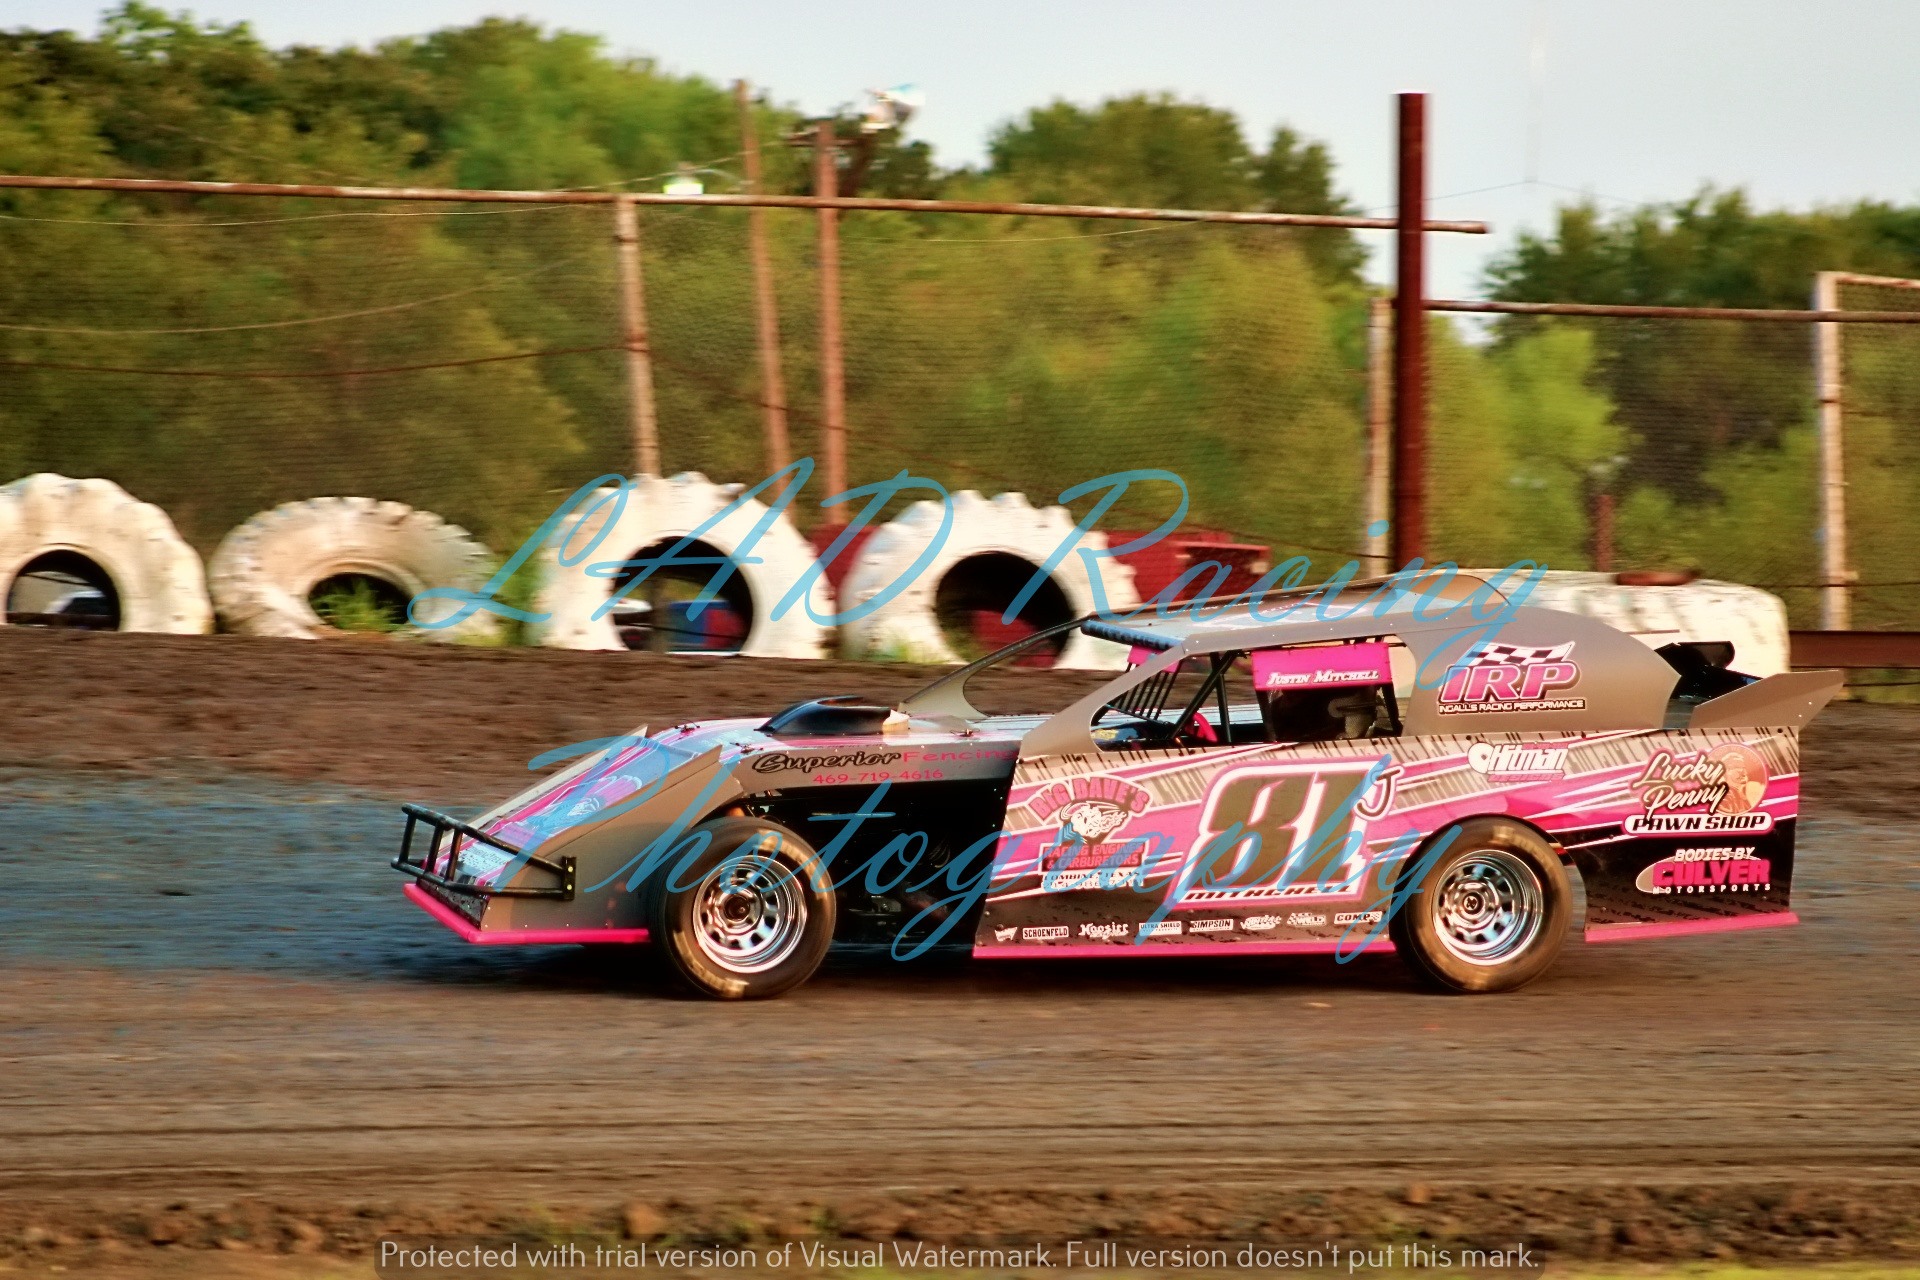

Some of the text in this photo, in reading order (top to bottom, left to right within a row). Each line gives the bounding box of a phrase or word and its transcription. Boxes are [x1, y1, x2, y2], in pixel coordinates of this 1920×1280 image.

[1440, 662, 1580, 703] IRP
[1479, 702, 1512, 712] RACING
[1514, 699, 1584, 711] PERFORMANCE
[752, 750, 902, 774] Superior
[1488, 741, 1569, 771] Hitman
[813, 768, 944, 785] 469-719-4616
[1632, 752, 1726, 788] Lucky
[1028, 776, 1150, 821] BIG DAVE'S
[1642, 783, 1728, 821] Penny
[1185, 764, 1370, 888] 81
[1632, 815, 1766, 832] PAWN SHOP
[1652, 860, 1771, 885] CULVER
[1024, 927, 1068, 938] SCHOENFELD
[1192, 921, 1231, 929] SIMPSON
